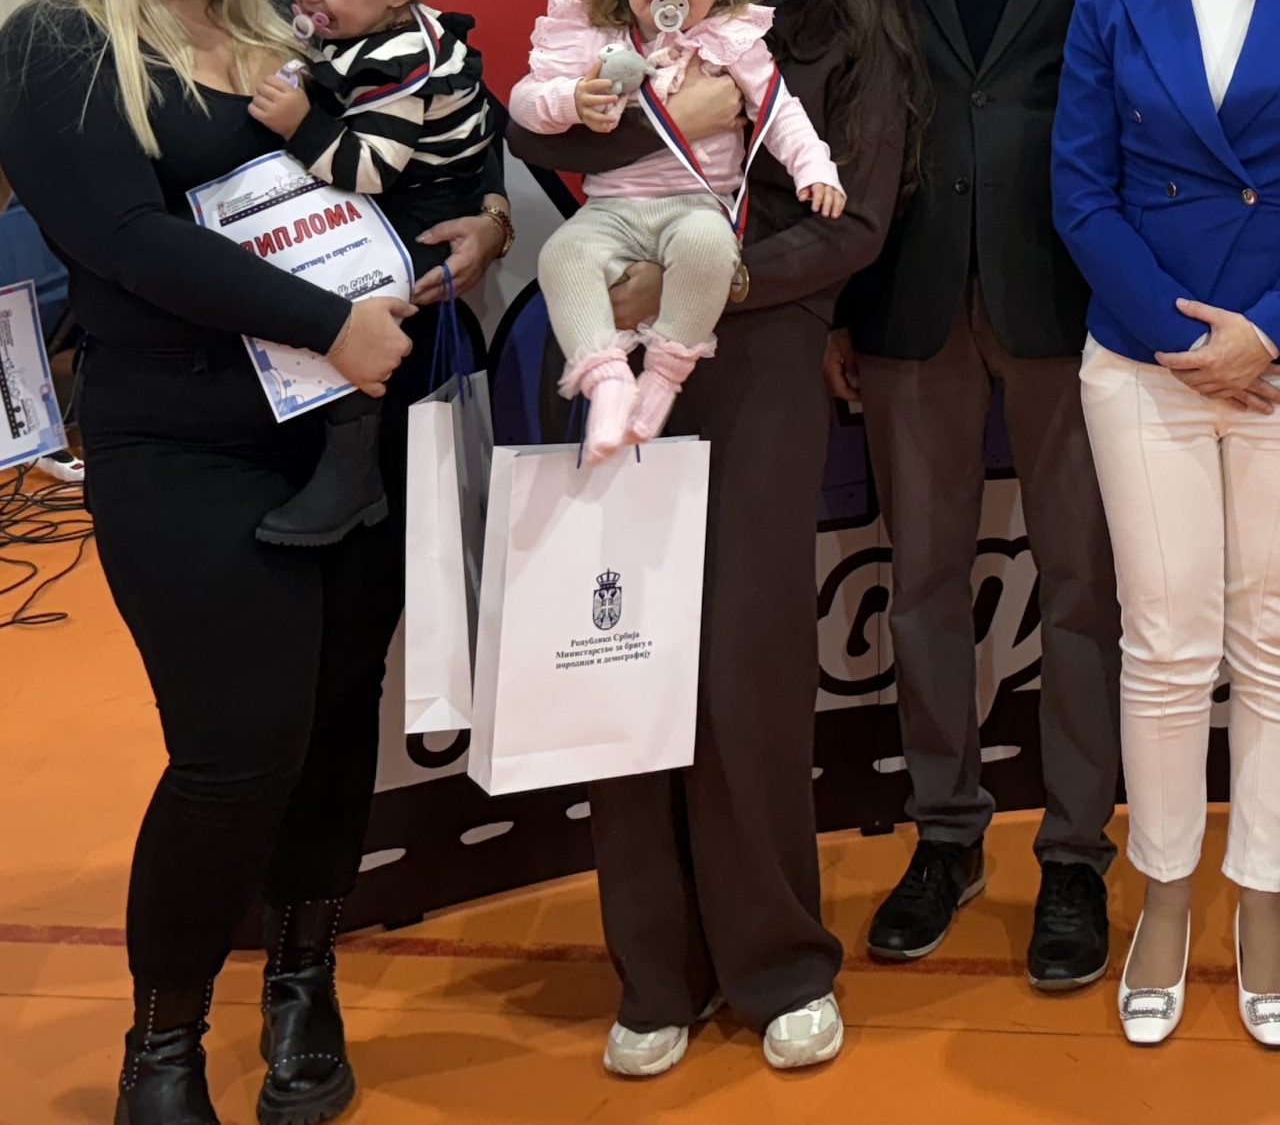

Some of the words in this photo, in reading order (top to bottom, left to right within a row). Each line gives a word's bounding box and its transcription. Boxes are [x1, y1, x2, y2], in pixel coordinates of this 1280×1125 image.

[571, 635, 612, 647] Република
[613, 631, 640, 644] Србија
[555, 645, 614, 659] Министарство
[624, 641, 646, 650] бригу
[555, 658, 595, 669] породици
[603, 650, 651, 664] демографију
